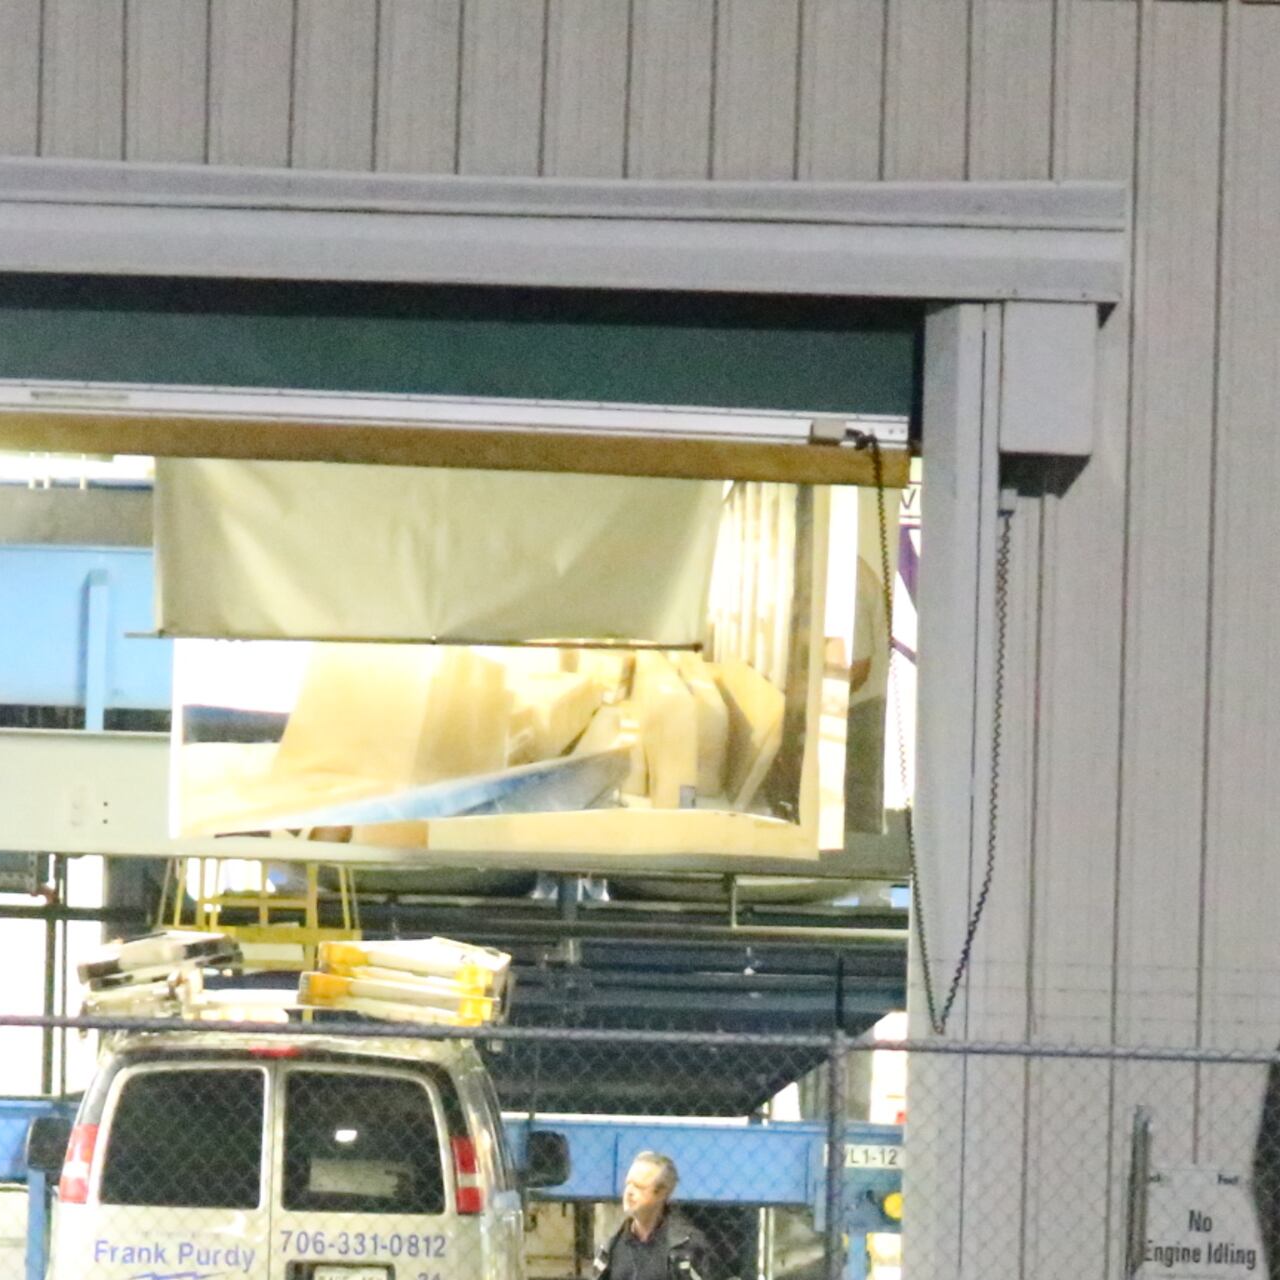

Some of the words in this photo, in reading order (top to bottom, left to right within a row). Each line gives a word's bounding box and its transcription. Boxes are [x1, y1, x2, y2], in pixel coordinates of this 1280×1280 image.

[1188, 1209, 1213, 1233] No
[94, 1239, 167, 1265] Frank
[178, 1241, 256, 1274] Purdy
[280, 1230, 447, 1258] 706-331-0812
[1207, 1241, 1257, 1271] Idling
